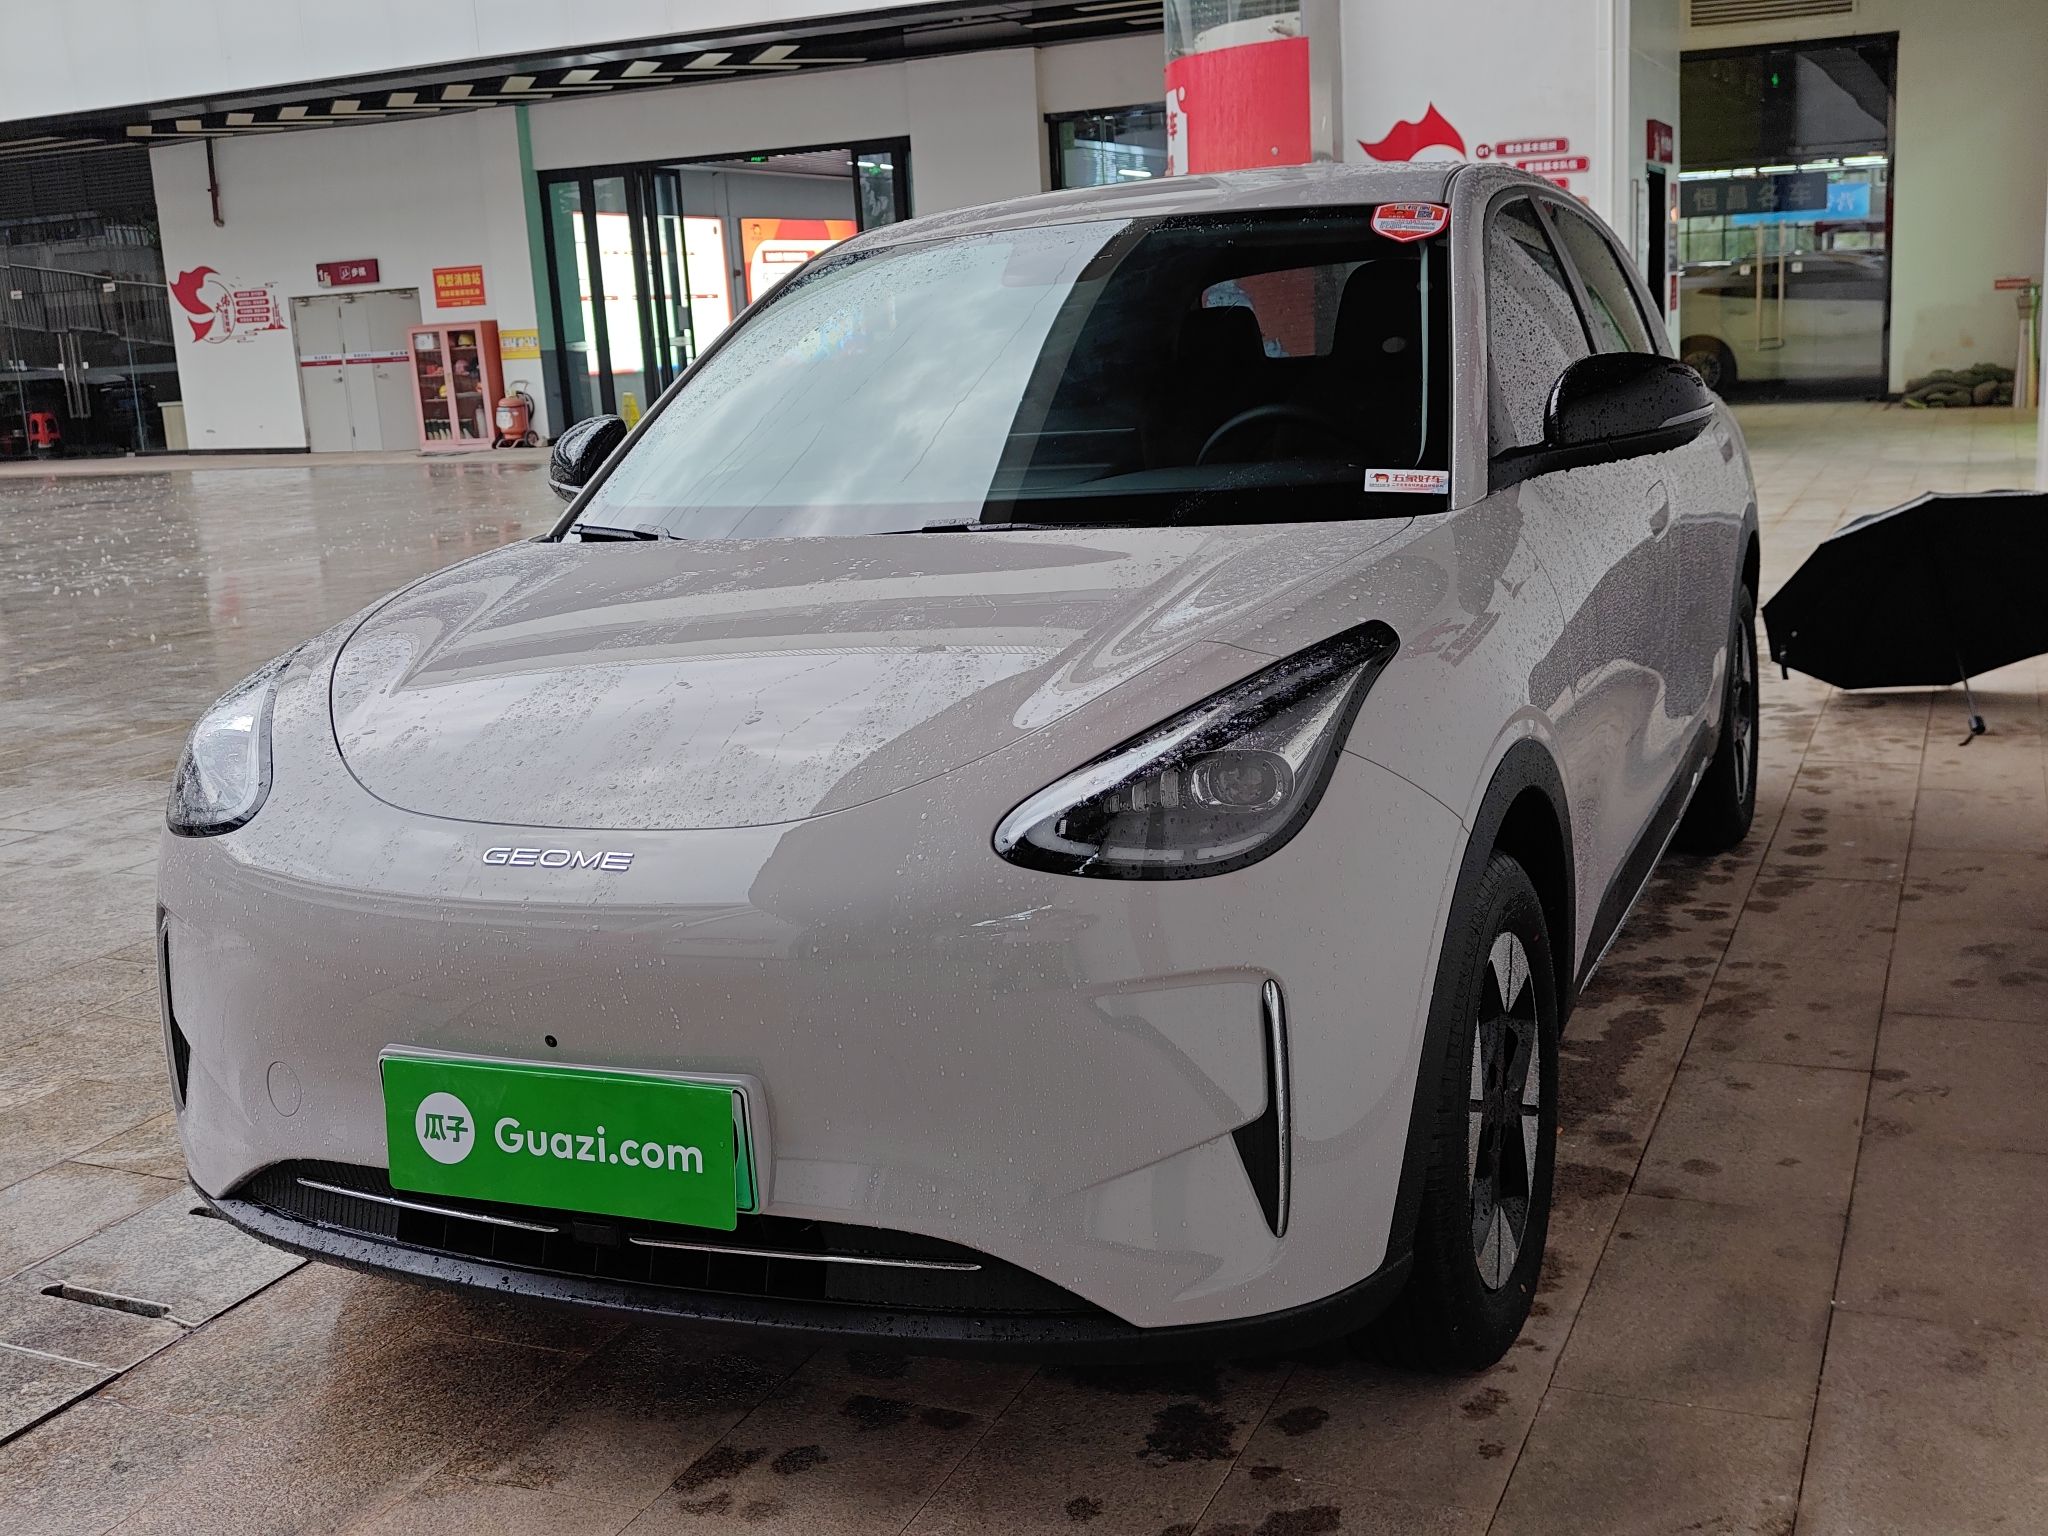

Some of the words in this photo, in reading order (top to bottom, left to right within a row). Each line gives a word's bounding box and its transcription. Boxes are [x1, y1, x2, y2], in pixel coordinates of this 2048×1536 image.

[482, 847, 635, 872] GEOME
[423, 1113, 469, 1143] 瓜子
[494, 1117, 704, 1174] Guazi.com
